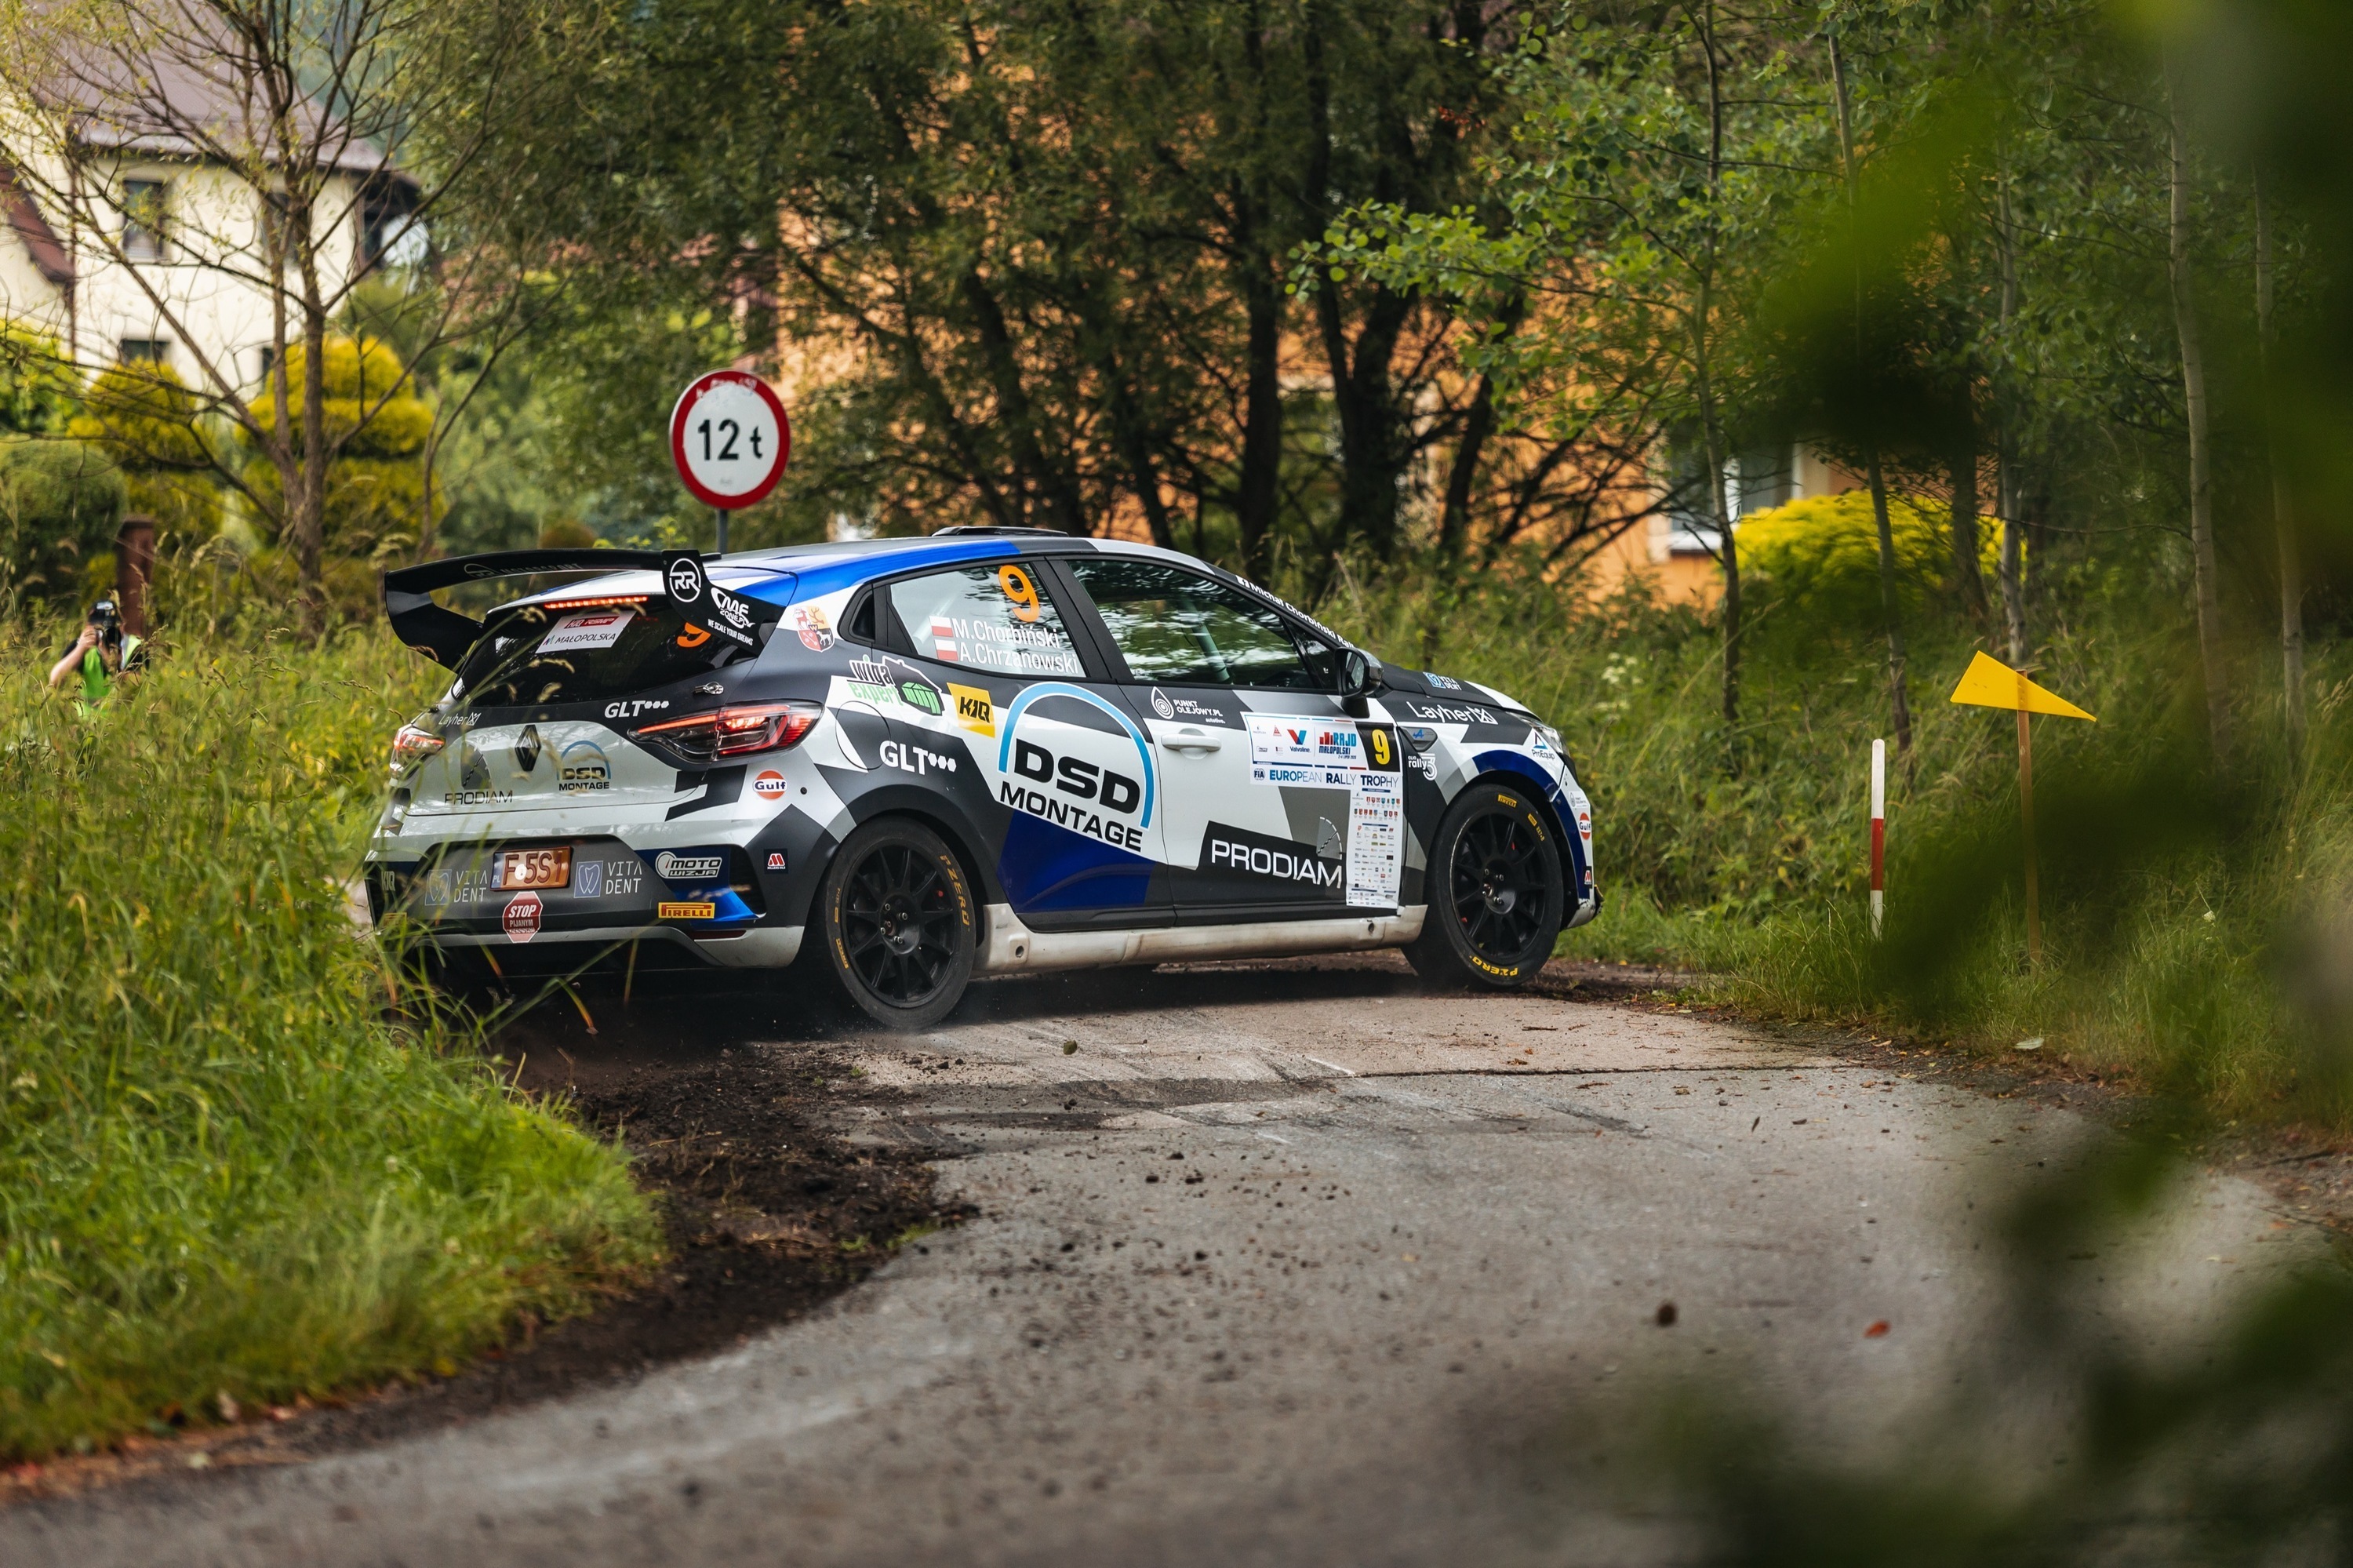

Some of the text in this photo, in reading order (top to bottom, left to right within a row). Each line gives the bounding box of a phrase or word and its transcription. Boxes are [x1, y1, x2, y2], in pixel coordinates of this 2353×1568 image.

[697, 419, 763, 461] 12 t
[669, 571, 701, 593] RR
[998, 565, 1040, 622] 9
[554, 633, 616, 645] MAŁOPOLSKA
[707, 618, 754, 646] WE SCALE YOUR DREAMS
[951, 618, 1060, 649] M.Chorbiński
[959, 642, 1078, 674] A.Chrzanowski
[852, 654, 894, 686] wiga
[849, 682, 904, 705] expert
[604, 700, 646, 719] GLT
[1173, 699, 1198, 708] PUNKT
[1176, 706, 1224, 717] OLEJOWY.PL
[1406, 701, 1475, 722] Layher
[438, 713, 468, 728] Layher
[1333, 732, 1356, 747] RAJD
[1319, 746, 1351, 755] MAŁOPOLSKI
[1372, 729, 1390, 766] 9
[1532, 749, 1555, 761] ProEquip
[879, 740, 928, 775] GLT
[1408, 759, 1427, 770] rally
[562, 766, 606, 780] DSD
[1014, 738, 1140, 814] DSD
[1269, 769, 1399, 788] EUROPEAN RALLY TROPHY
[558, 782, 609, 791] MONTAGE
[755, 781, 786, 790] Gulf
[445, 791, 512, 805] PRODIAM
[1000, 780, 1143, 853] MONTAGE
[1579, 821, 1591, 831] Gulf
[608, 861, 642, 876] VITA
[670, 859, 721, 868] MOTO
[1211, 839, 1342, 890] PRODIAM
[456, 870, 488, 885] VITA
[492, 875, 501, 883] PL
[606, 878, 642, 895] DENT
[453, 887, 487, 903] DENT
[508, 904, 537, 918] STOP
[660, 904, 712, 917] PIRELLI
[510, 919, 533, 928] PIJANYM
